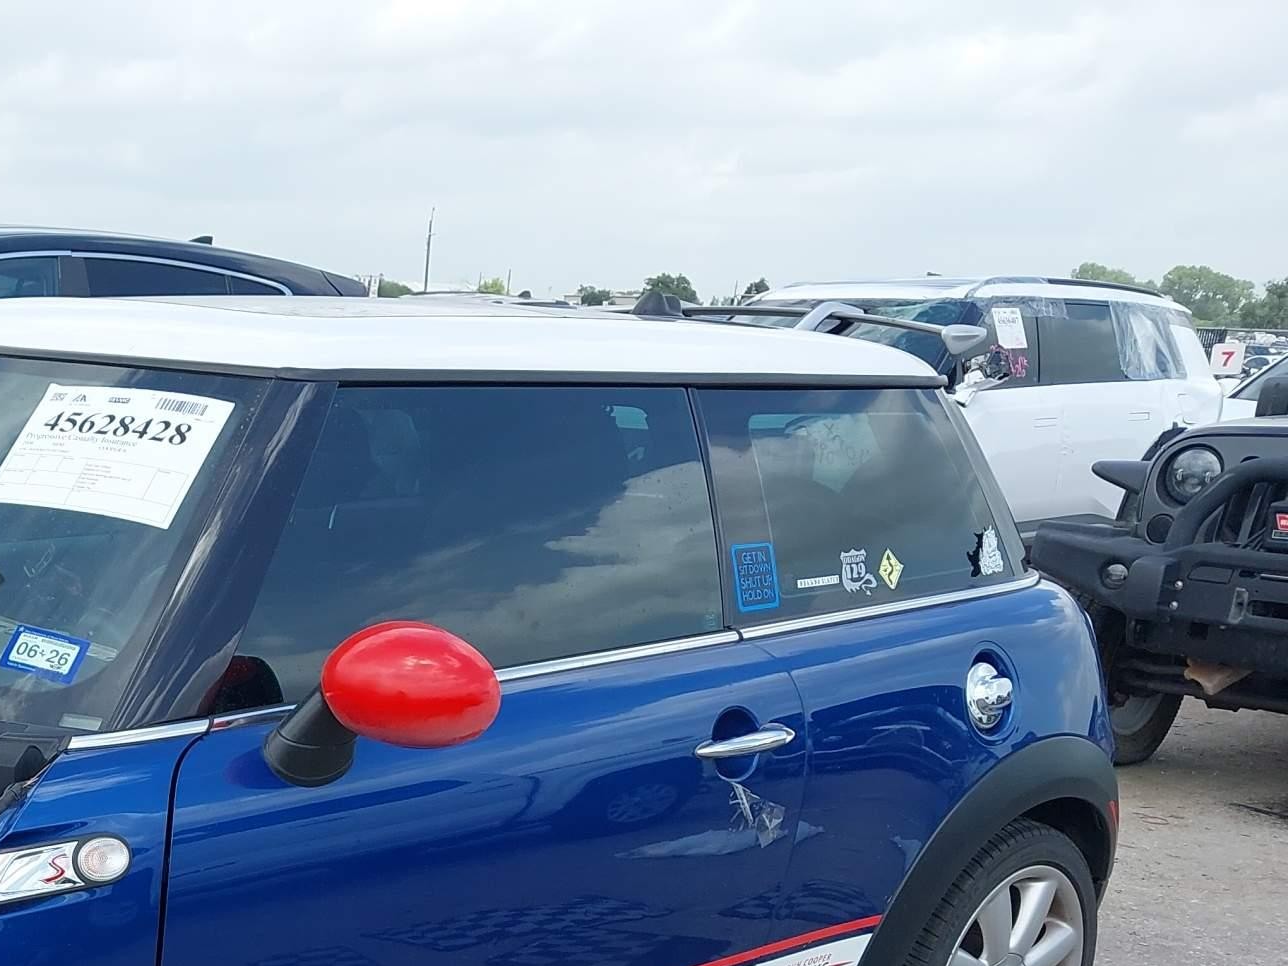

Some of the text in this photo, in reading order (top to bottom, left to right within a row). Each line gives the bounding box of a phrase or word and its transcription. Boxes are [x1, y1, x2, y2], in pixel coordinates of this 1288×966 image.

[1221, 351, 1236, 367] 7
[44, 411, 192, 446] 45628428
[100, 436, 138, 448] Insurance
[741, 551, 766, 564] GET IN
[739, 563, 771, 575] SIT DOWN
[845, 562, 866, 579] 129
[740, 574, 773, 589] SHUT UP
[742, 588, 775, 601] HOLD ON
[16, 641, 40, 659] 06
[45, 649, 71, 667] 26
[802, 953, 832, 966] COOPER
